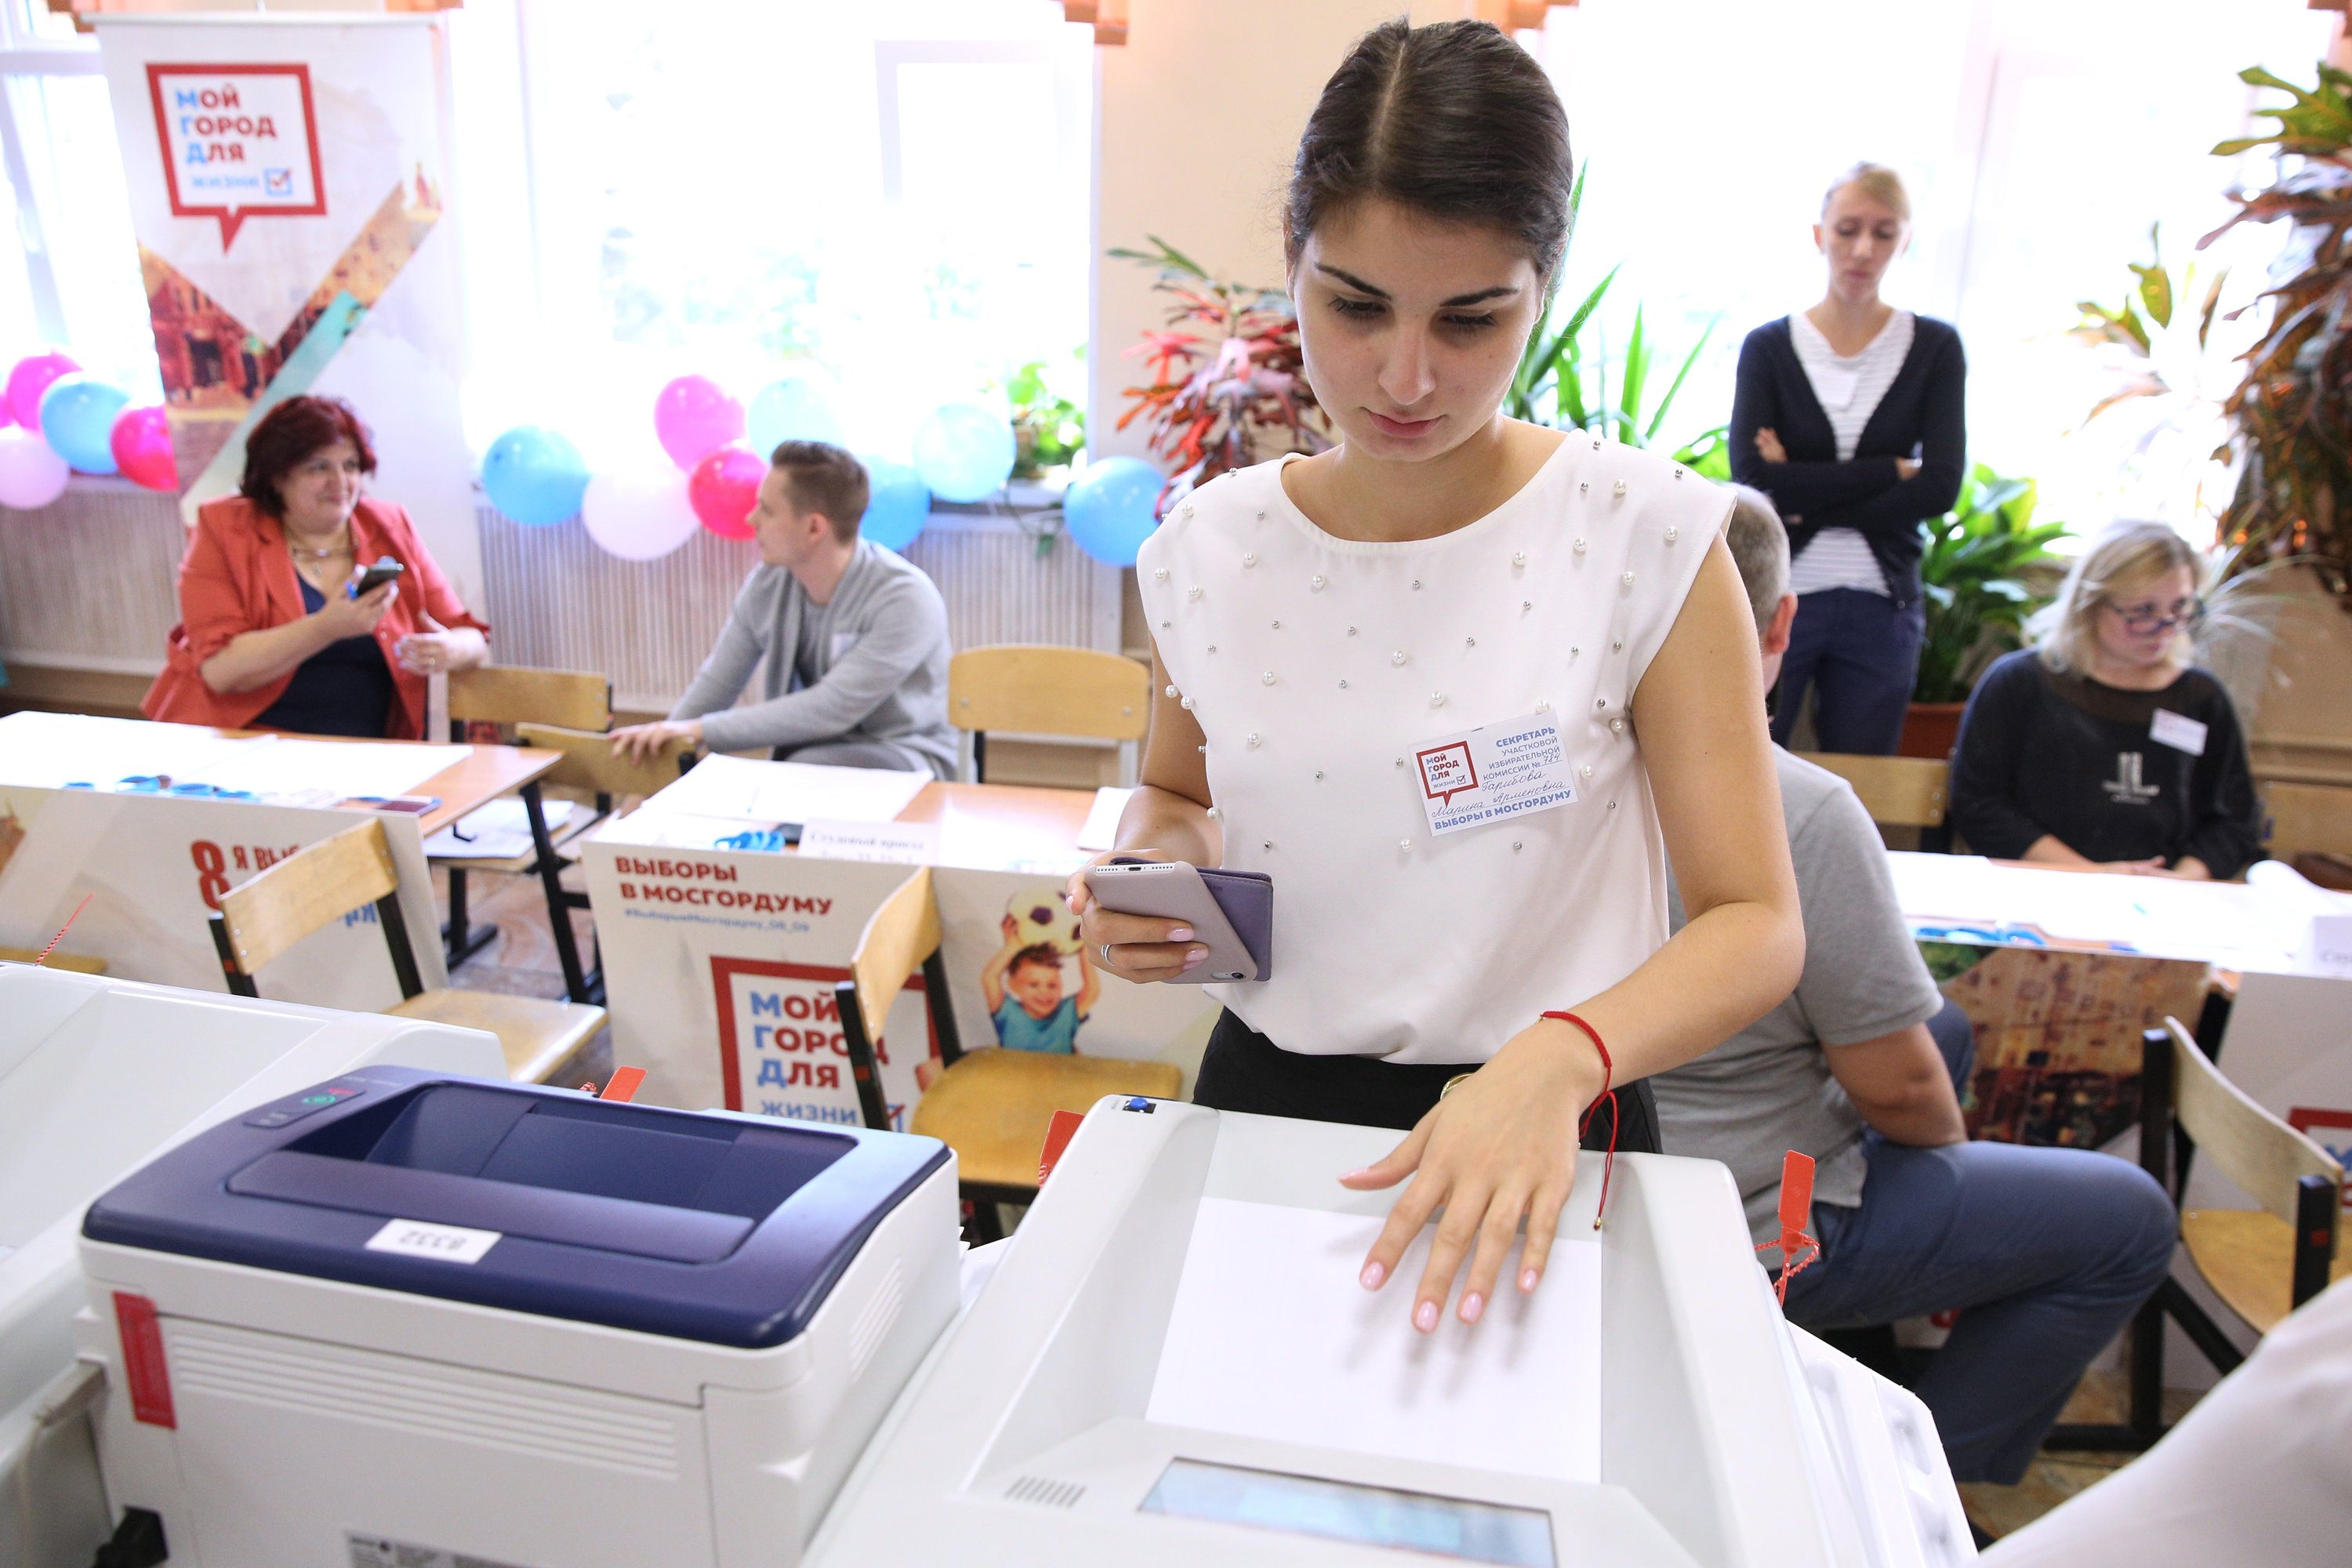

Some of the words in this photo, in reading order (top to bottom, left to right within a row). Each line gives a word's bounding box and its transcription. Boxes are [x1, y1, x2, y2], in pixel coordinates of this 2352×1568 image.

[176, 83, 240, 108] МОЙ
[180, 115, 278, 138] ГОРОД
[186, 141, 245, 165] ДЛЯ
[1496, 727, 1555, 748] СЕКРЕТАРЬ
[1501, 735, 1558, 757] УЧАСТКОВОЙ
[1425, 753, 1447, 765] МОЙ
[1428, 760, 1460, 773] ГОРОД
[1488, 746, 1560, 770] ИЗБИРАТЕЛЬНОЙ
[1431, 770, 1450, 782] ДЛЯ
[1483, 764, 1530, 781] КОМИССИИ
[1531, 760, 1541, 769] №
[1434, 811, 1484, 830] ВЫБОРЫ
[1485, 809, 1493, 818] В
[1494, 789, 1571, 816] МОСГОРДУМУ
[233, 845, 249, 870] Я
[615, 855, 739, 883] ВЫБОРЫ
[619, 882, 637, 900] В
[642, 884, 833, 916] МОСГОРДУМУ
[750, 991, 840, 1024] МОЙ
[757, 1058, 840, 1090] ДЛЯ
